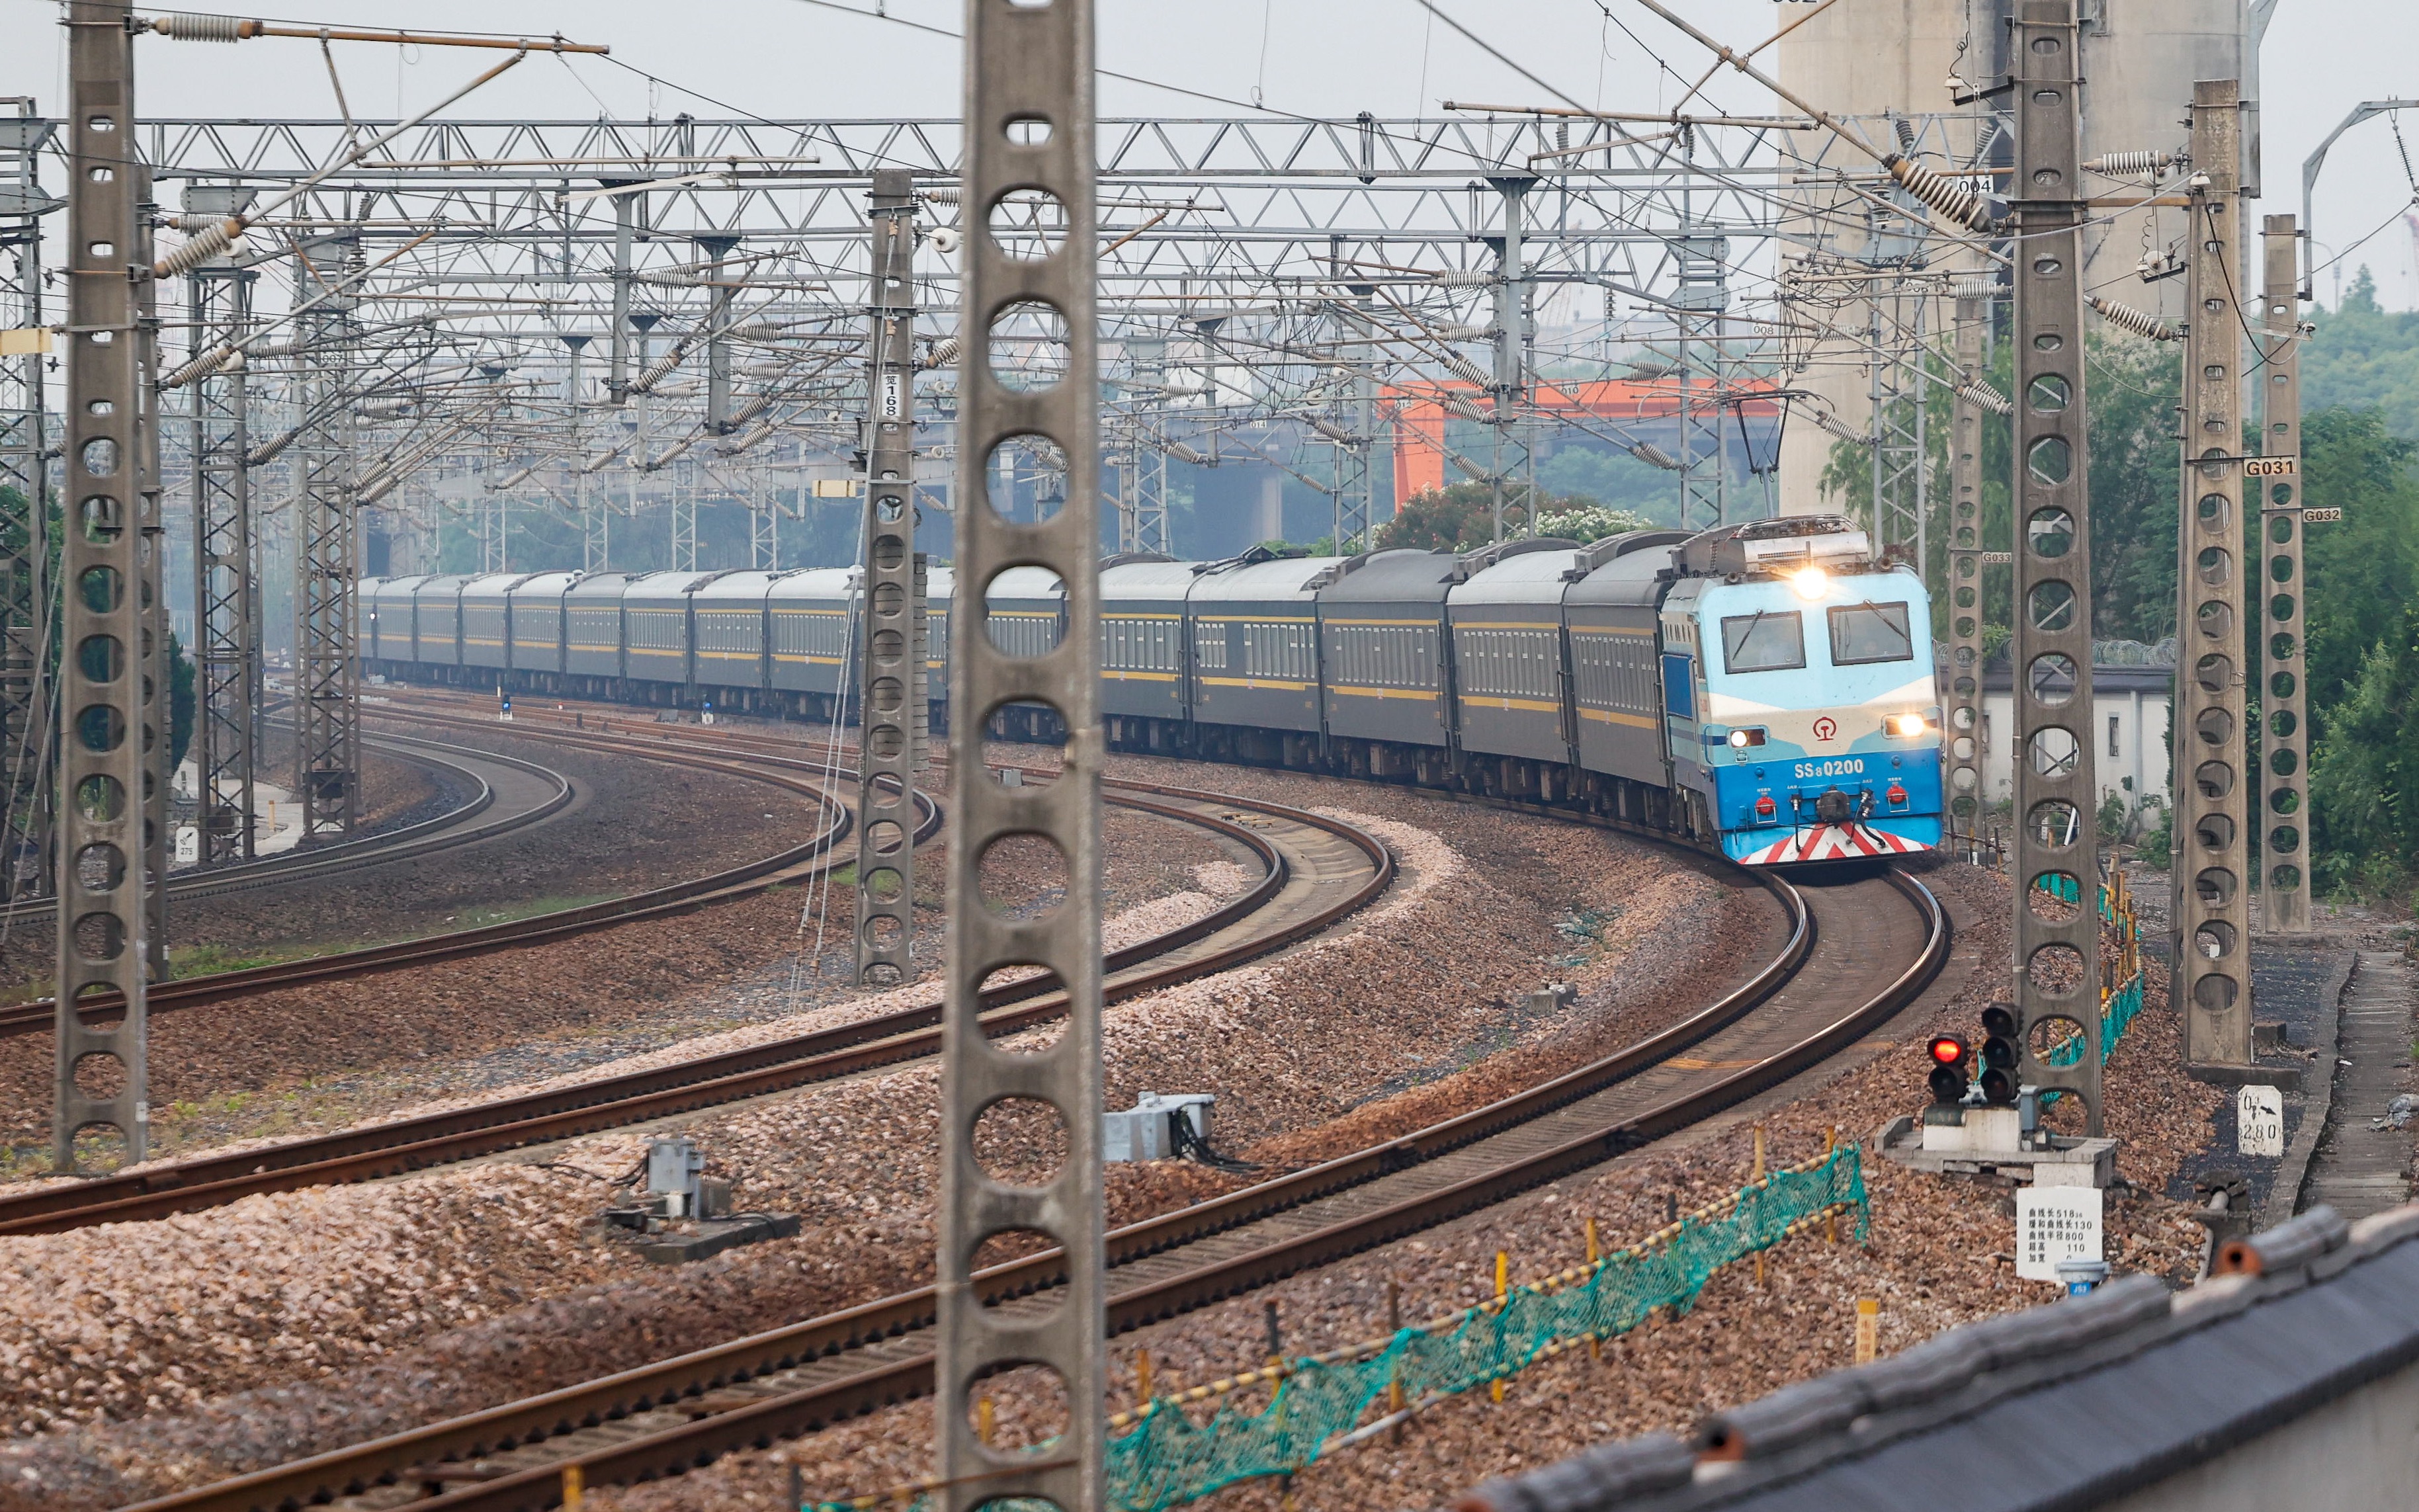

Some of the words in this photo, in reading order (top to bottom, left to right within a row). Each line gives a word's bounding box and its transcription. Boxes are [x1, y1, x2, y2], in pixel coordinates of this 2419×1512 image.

[1959, 180, 1991, 193] 004
[1754, 325, 1774, 335] 008
[2246, 460, 2294, 476] G031
[2305, 510, 2340, 521] G032
[1984, 553, 2010, 562] G033
[2244, 1124, 2276, 1140] 280
[2067, 1243, 2084, 1252] 110
